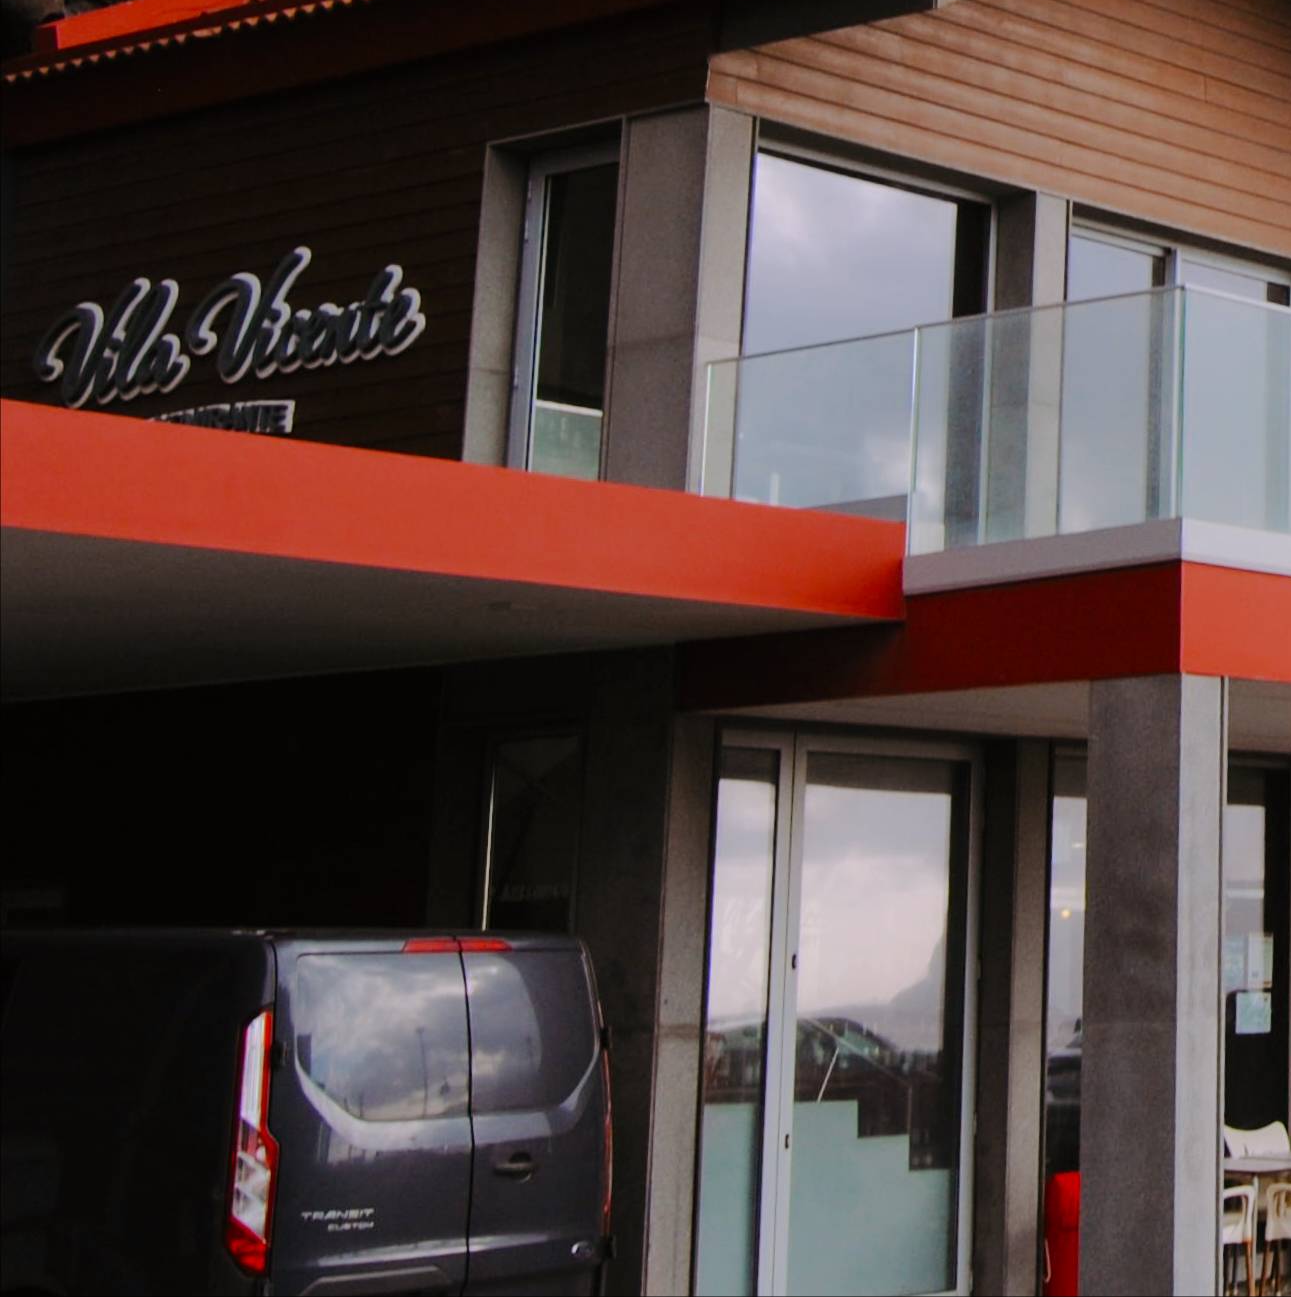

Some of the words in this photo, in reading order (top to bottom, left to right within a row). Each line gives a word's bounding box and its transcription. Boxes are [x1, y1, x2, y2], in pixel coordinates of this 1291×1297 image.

[35, 277, 190, 408] Vila
[188, 246, 425, 384] Vicente
[301, 1208, 375, 1220] TRANSIT
